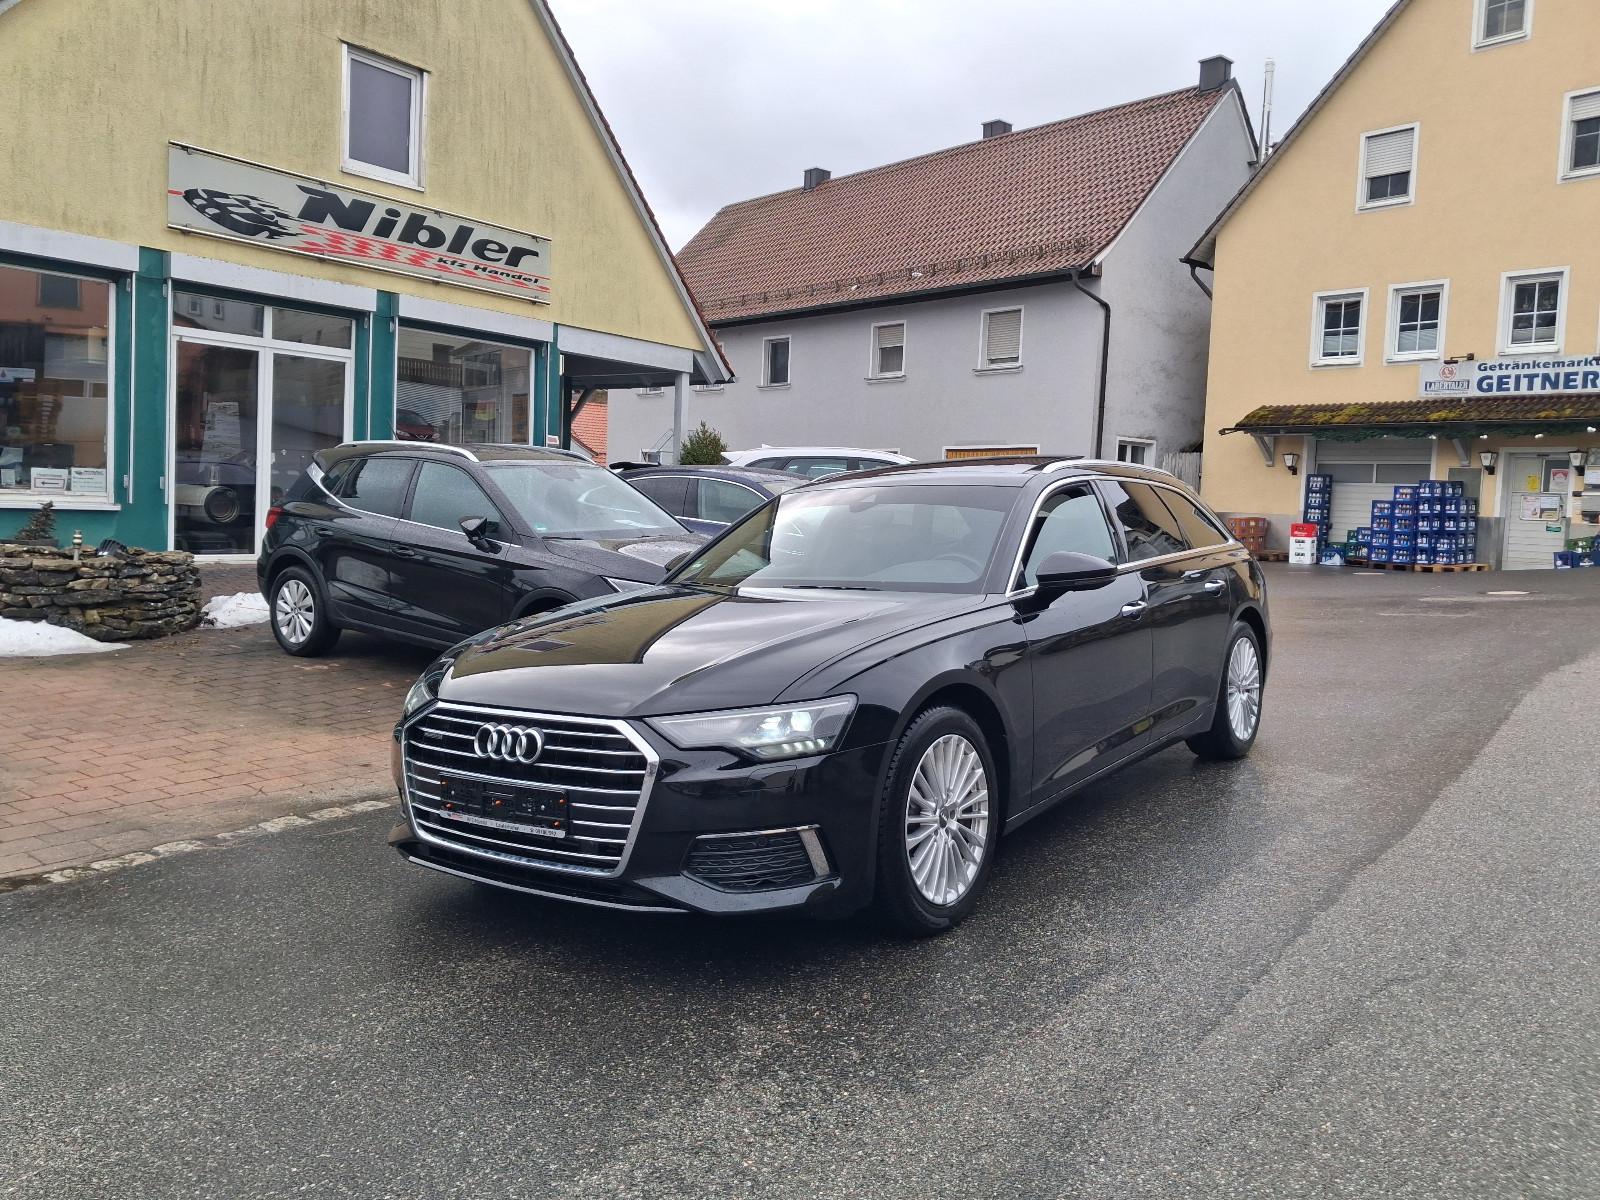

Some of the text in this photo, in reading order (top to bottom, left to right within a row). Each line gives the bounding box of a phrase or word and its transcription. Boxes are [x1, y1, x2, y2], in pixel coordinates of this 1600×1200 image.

[296, 184, 540, 267] Nibler
[473, 264, 539, 284] Handel
[1476, 370, 1600, 393] GEITNER
